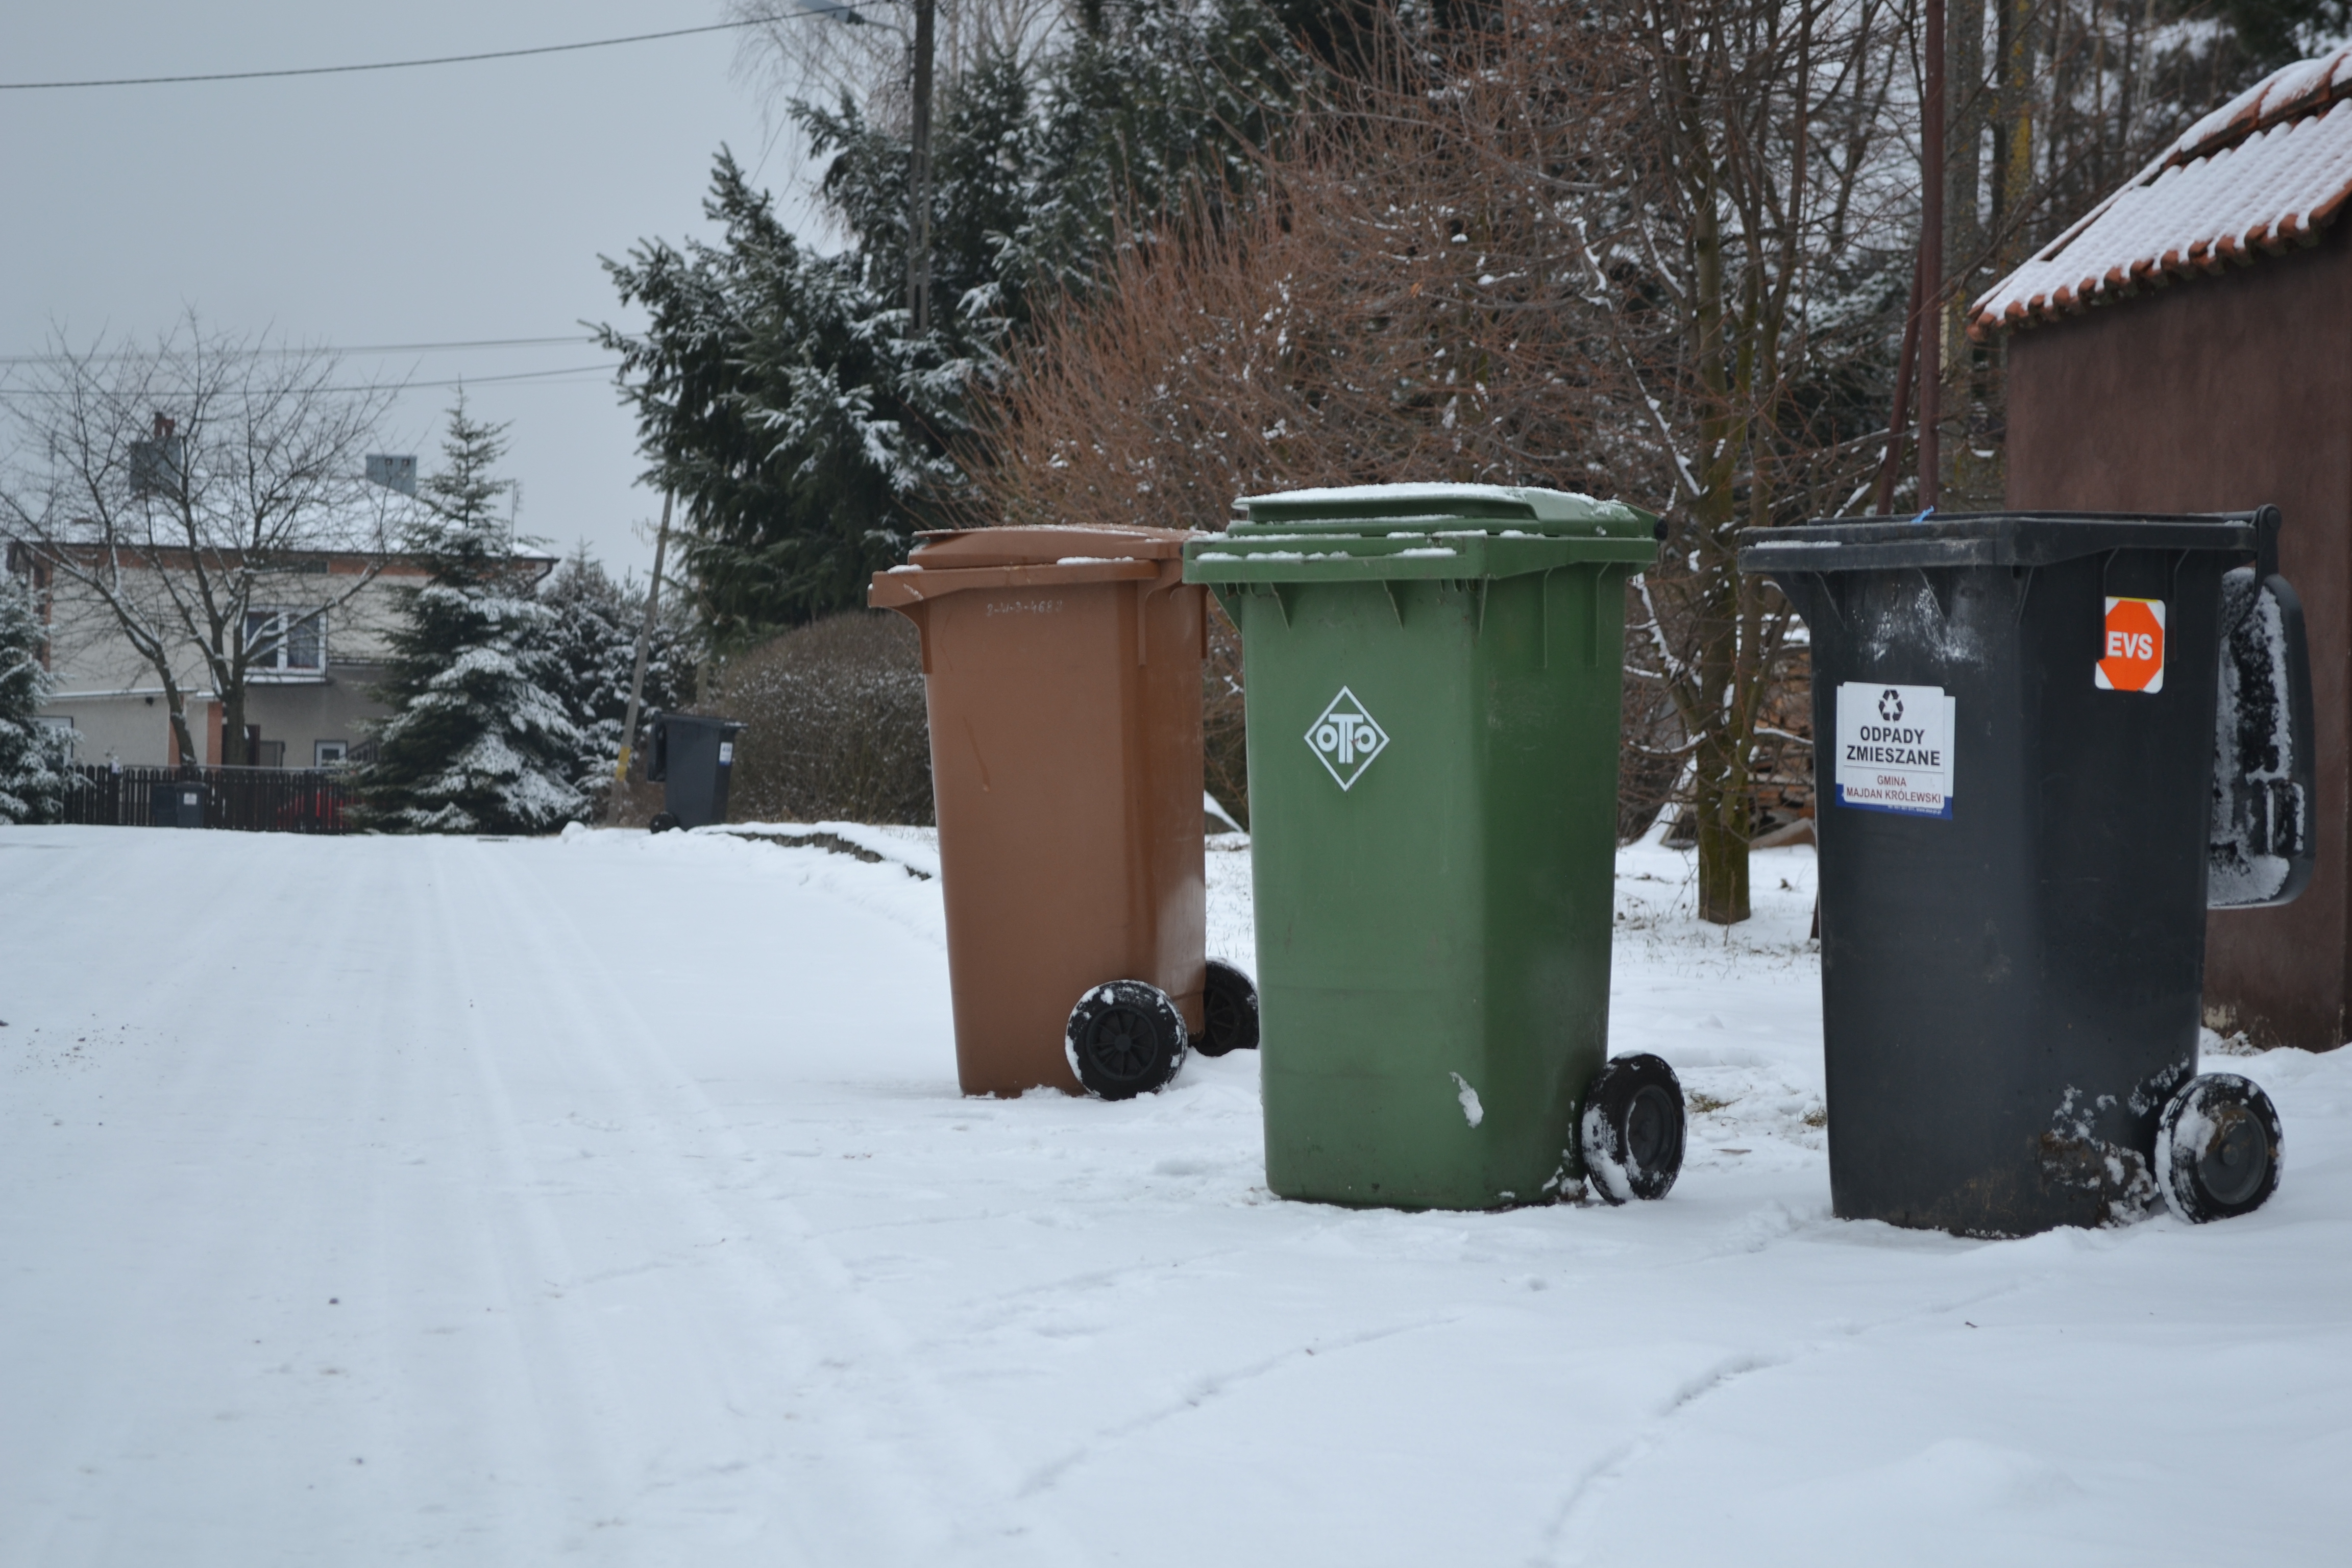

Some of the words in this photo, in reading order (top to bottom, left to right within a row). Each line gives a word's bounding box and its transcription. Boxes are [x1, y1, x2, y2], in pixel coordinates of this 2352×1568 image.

[2108, 631, 2153, 660] EVS
[1316, 714, 1377, 764] OTTO
[1860, 725, 1925, 744] ODPADY
[1847, 745, 1940, 766] ZMIESZANE
[1877, 775, 1906, 787] GMINA
[1846, 787, 1882, 799] MAJDAN
[1885, 788, 1941, 803] KRÓLEWSKI
